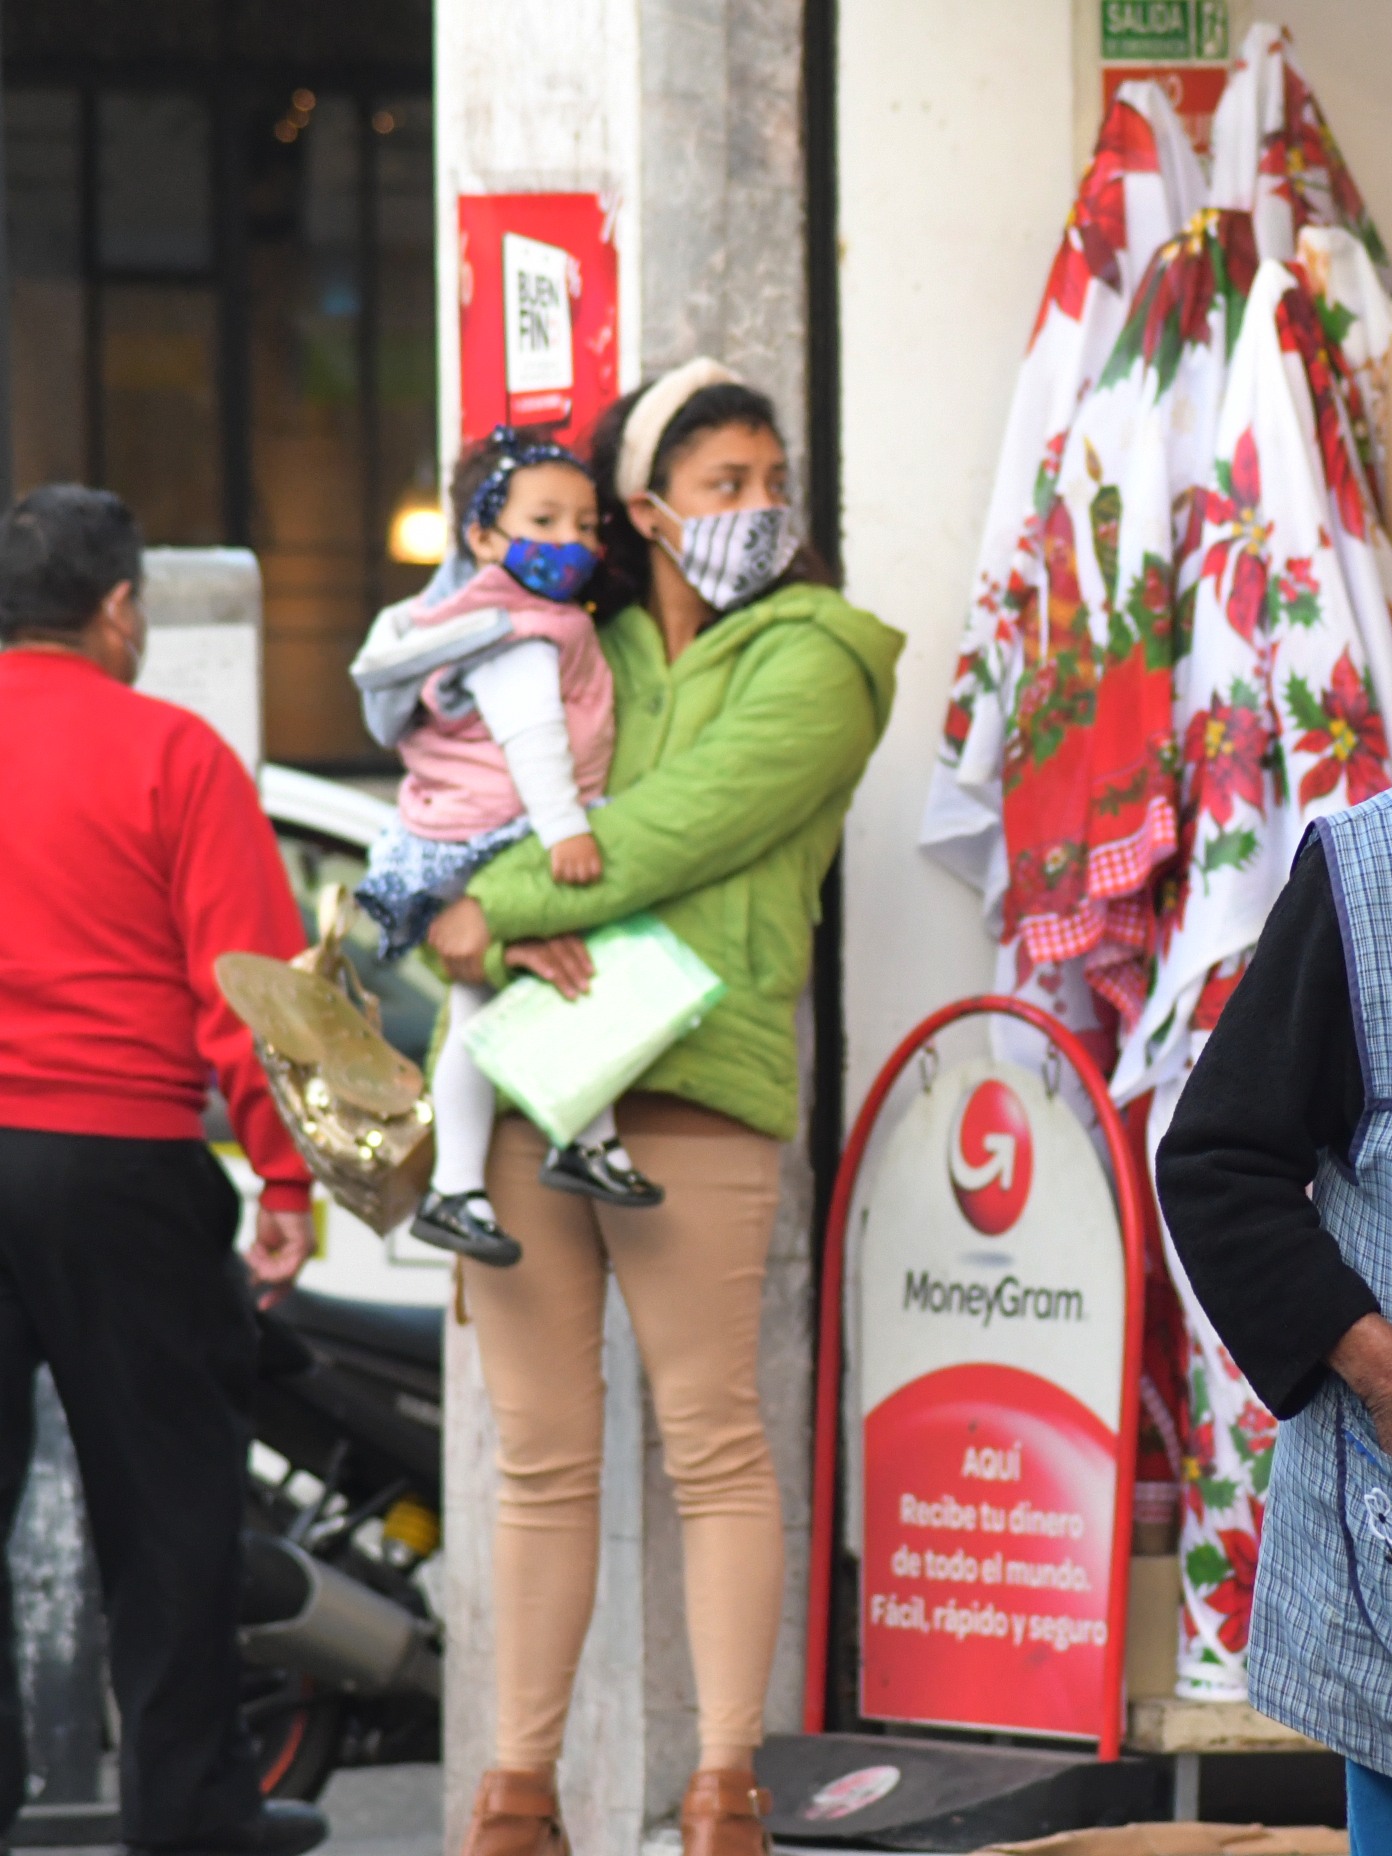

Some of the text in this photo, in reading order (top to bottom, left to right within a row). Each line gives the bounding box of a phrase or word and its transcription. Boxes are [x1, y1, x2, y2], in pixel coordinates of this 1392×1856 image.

[1107, 2, 1183, 34] SALIDA
[516, 269, 561, 309] BUEN
[902, 1269, 1083, 1329] MoneyGram
[960, 1438, 1023, 1482] AQUÍ
[899, 1492, 1085, 1540] Recibe tu dinero
[890, 1543, 1092, 1593] de todo el mundo.
[870, 1593, 1109, 1653] Fácil, rápido y seguro
